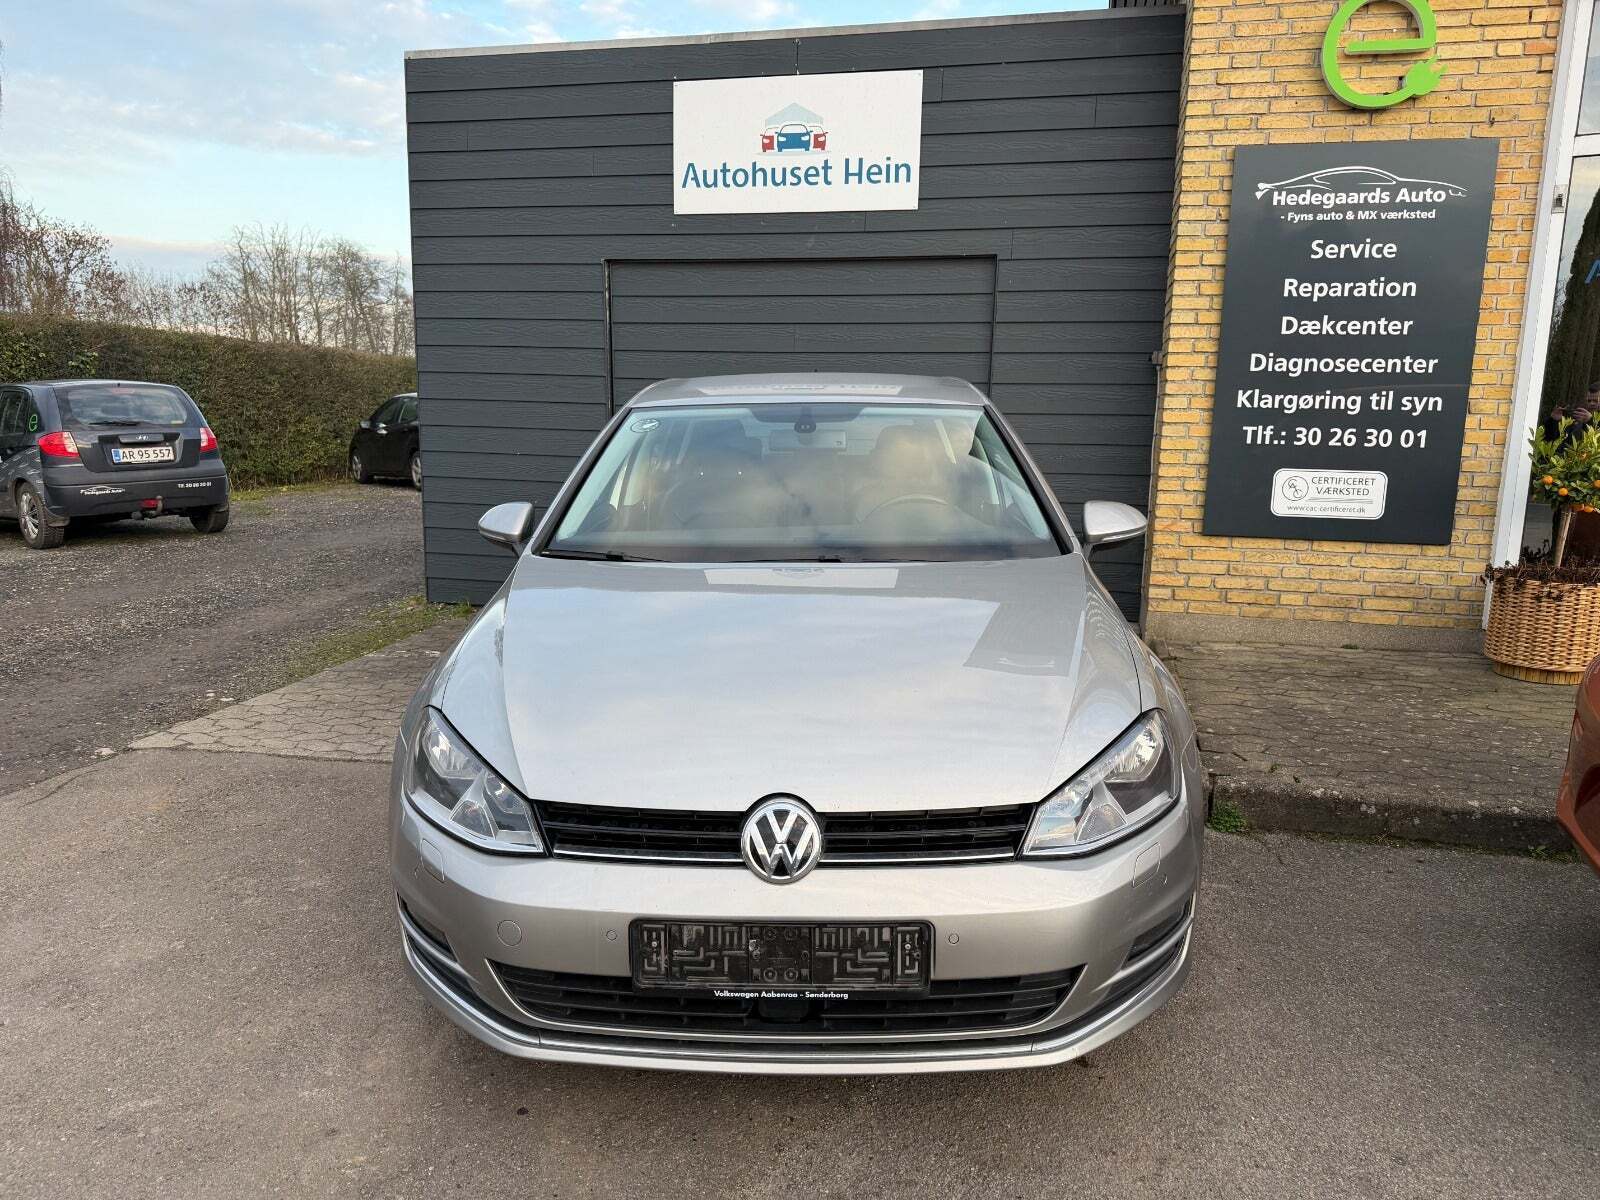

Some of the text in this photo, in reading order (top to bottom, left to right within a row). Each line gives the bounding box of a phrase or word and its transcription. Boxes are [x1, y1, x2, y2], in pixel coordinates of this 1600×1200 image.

[682, 155, 912, 189] Autohuset Hein
[1272, 186, 1447, 209] Hedegaards Auto
[1287, 211, 1315, 223] Fyns
[1315, 211, 1344, 221] auto
[1345, 210, 1356, 221] &
[1357, 210, 1378, 220] MX
[1379, 208, 1437, 221] værksted
[1310, 237, 1398, 259] Service
[1283, 276, 1418, 303] Reparation
[1280, 314, 1414, 336] Dækcenter
[1248, 351, 1439, 378] Diagnosecenter
[1236, 388, 1444, 416] Klargøring til syn
[1242, 425, 1428, 449] Tlf.: 30 26 30 01
[121, 448, 171, 460] AR 95 557
[1311, 476, 1377, 487] CERTIFICERET
[1316, 486, 1371, 497] VÆRKSTED
[713, 989, 760, 1000] Volkswagen
